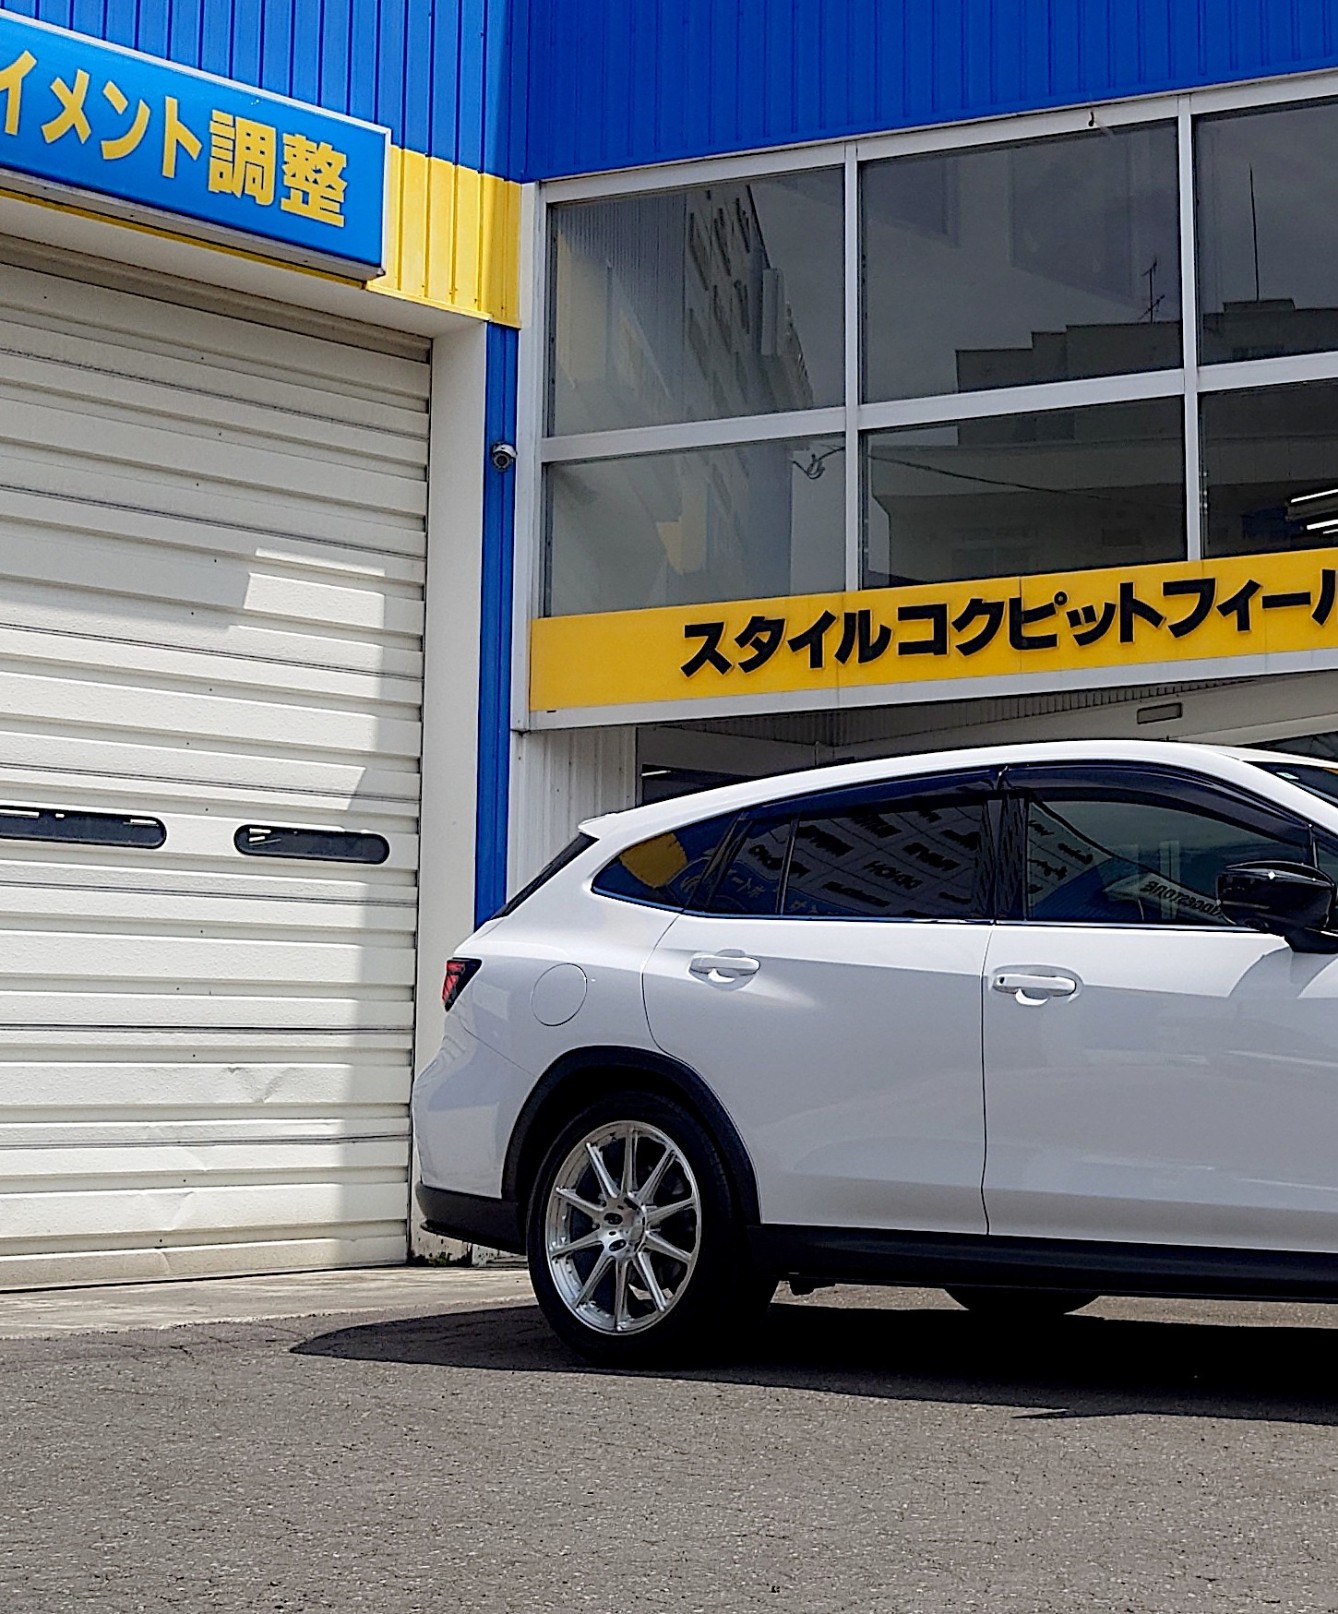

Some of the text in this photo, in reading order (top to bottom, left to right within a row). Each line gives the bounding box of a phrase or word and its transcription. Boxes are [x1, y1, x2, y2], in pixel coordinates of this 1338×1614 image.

[0, 49, 347, 228] イメント調整
